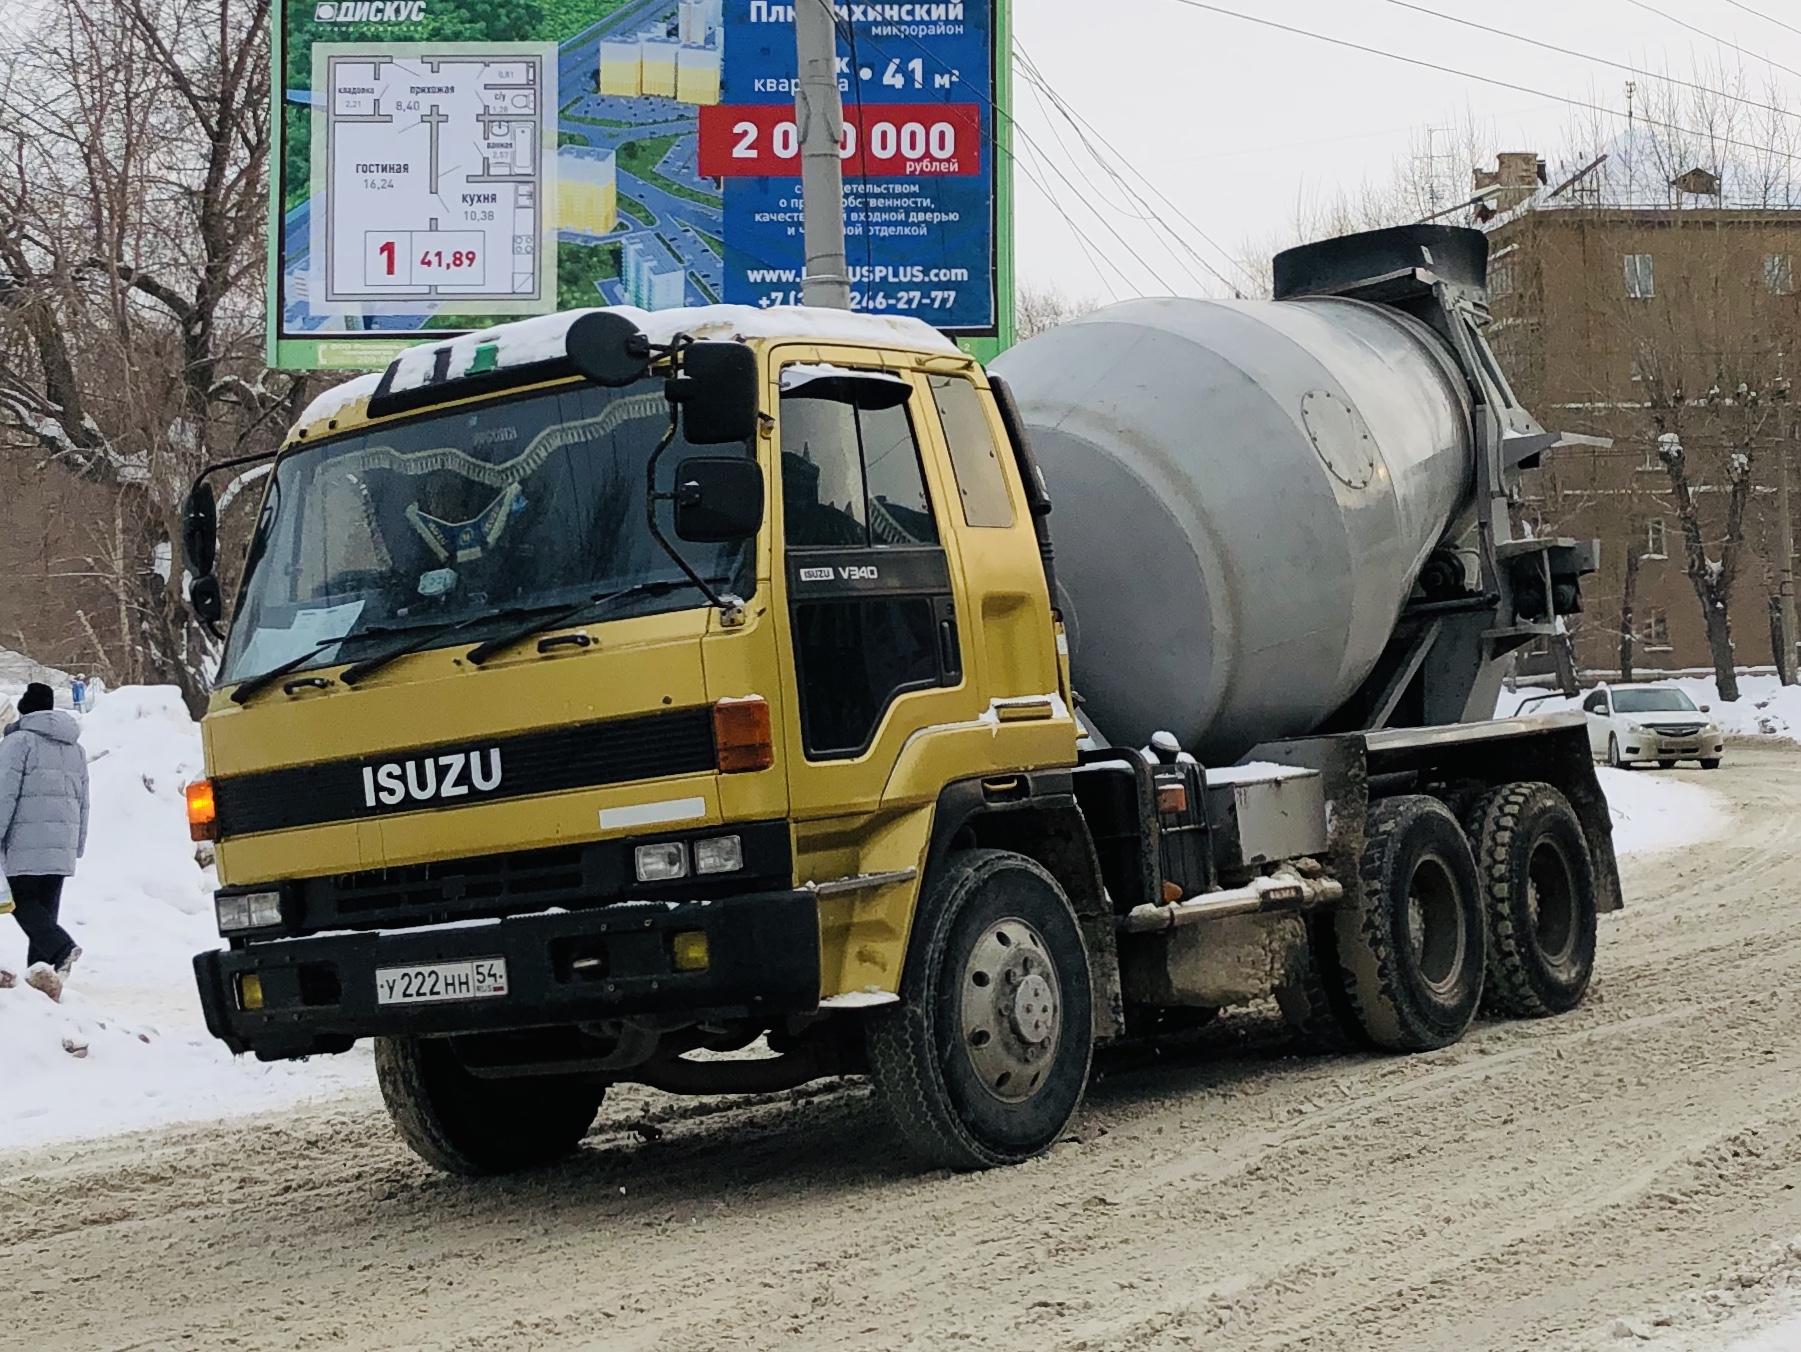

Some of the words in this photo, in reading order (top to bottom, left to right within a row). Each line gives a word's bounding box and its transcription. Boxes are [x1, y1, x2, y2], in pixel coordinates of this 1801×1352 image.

[336, 1, 427, 21] ДИСКУС
[872, 22, 963, 38] микрорайон
[882, 58, 923, 89] 41
[410, 85, 455, 96] прихожая
[754, 78, 849, 97] квара
[395, 101, 420, 112] 8,40
[732, 122, 758, 158] 2
[773, 122, 857, 159] 00
[871, 122, 955, 159] 000
[356, 163, 409, 174] гостиная
[905, 158, 959, 175] рублей
[363, 178, 394, 190] 16,24
[461, 193, 497, 206] кухня
[463, 210, 494, 222] 10,38
[909, 212, 959, 224] дверью
[379, 241, 395, 276] 1
[420, 250, 476, 271] 41,89
[850, 291, 956, 310] 246-27-77
[803, 569, 831, 579] ISUZU
[838, 566, 878, 579] V340
[362, 748, 502, 807] ISUZU
[475, 963, 498, 984] 54
